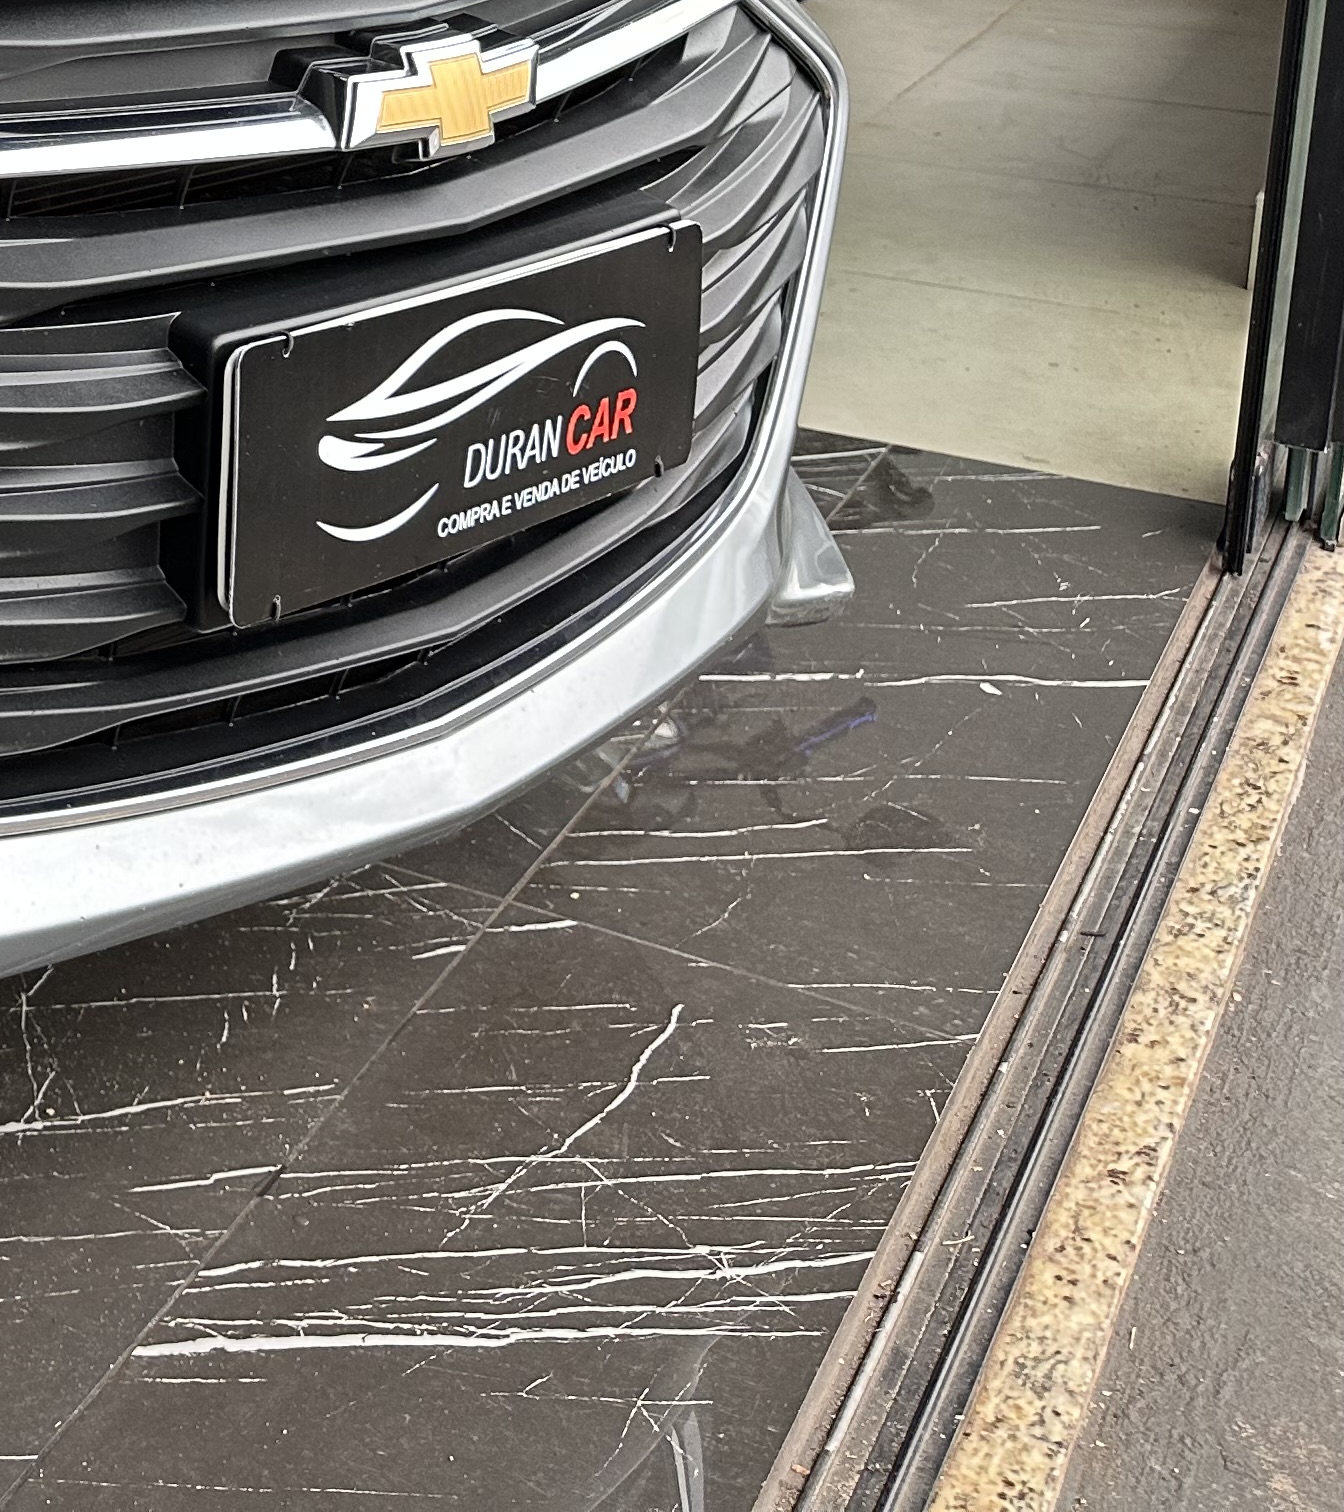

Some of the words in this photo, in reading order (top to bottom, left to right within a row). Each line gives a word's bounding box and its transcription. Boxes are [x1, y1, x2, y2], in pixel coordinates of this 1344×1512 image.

[463, 415, 563, 488] DURAN
[565, 387, 638, 456] CAR
[437, 499, 501, 538] COMPRA
[501, 495, 513, 516] E
[514, 477, 561, 510] VENDA
[561, 470, 580, 494] DE
[582, 448, 637, 485] VEÍCULO
